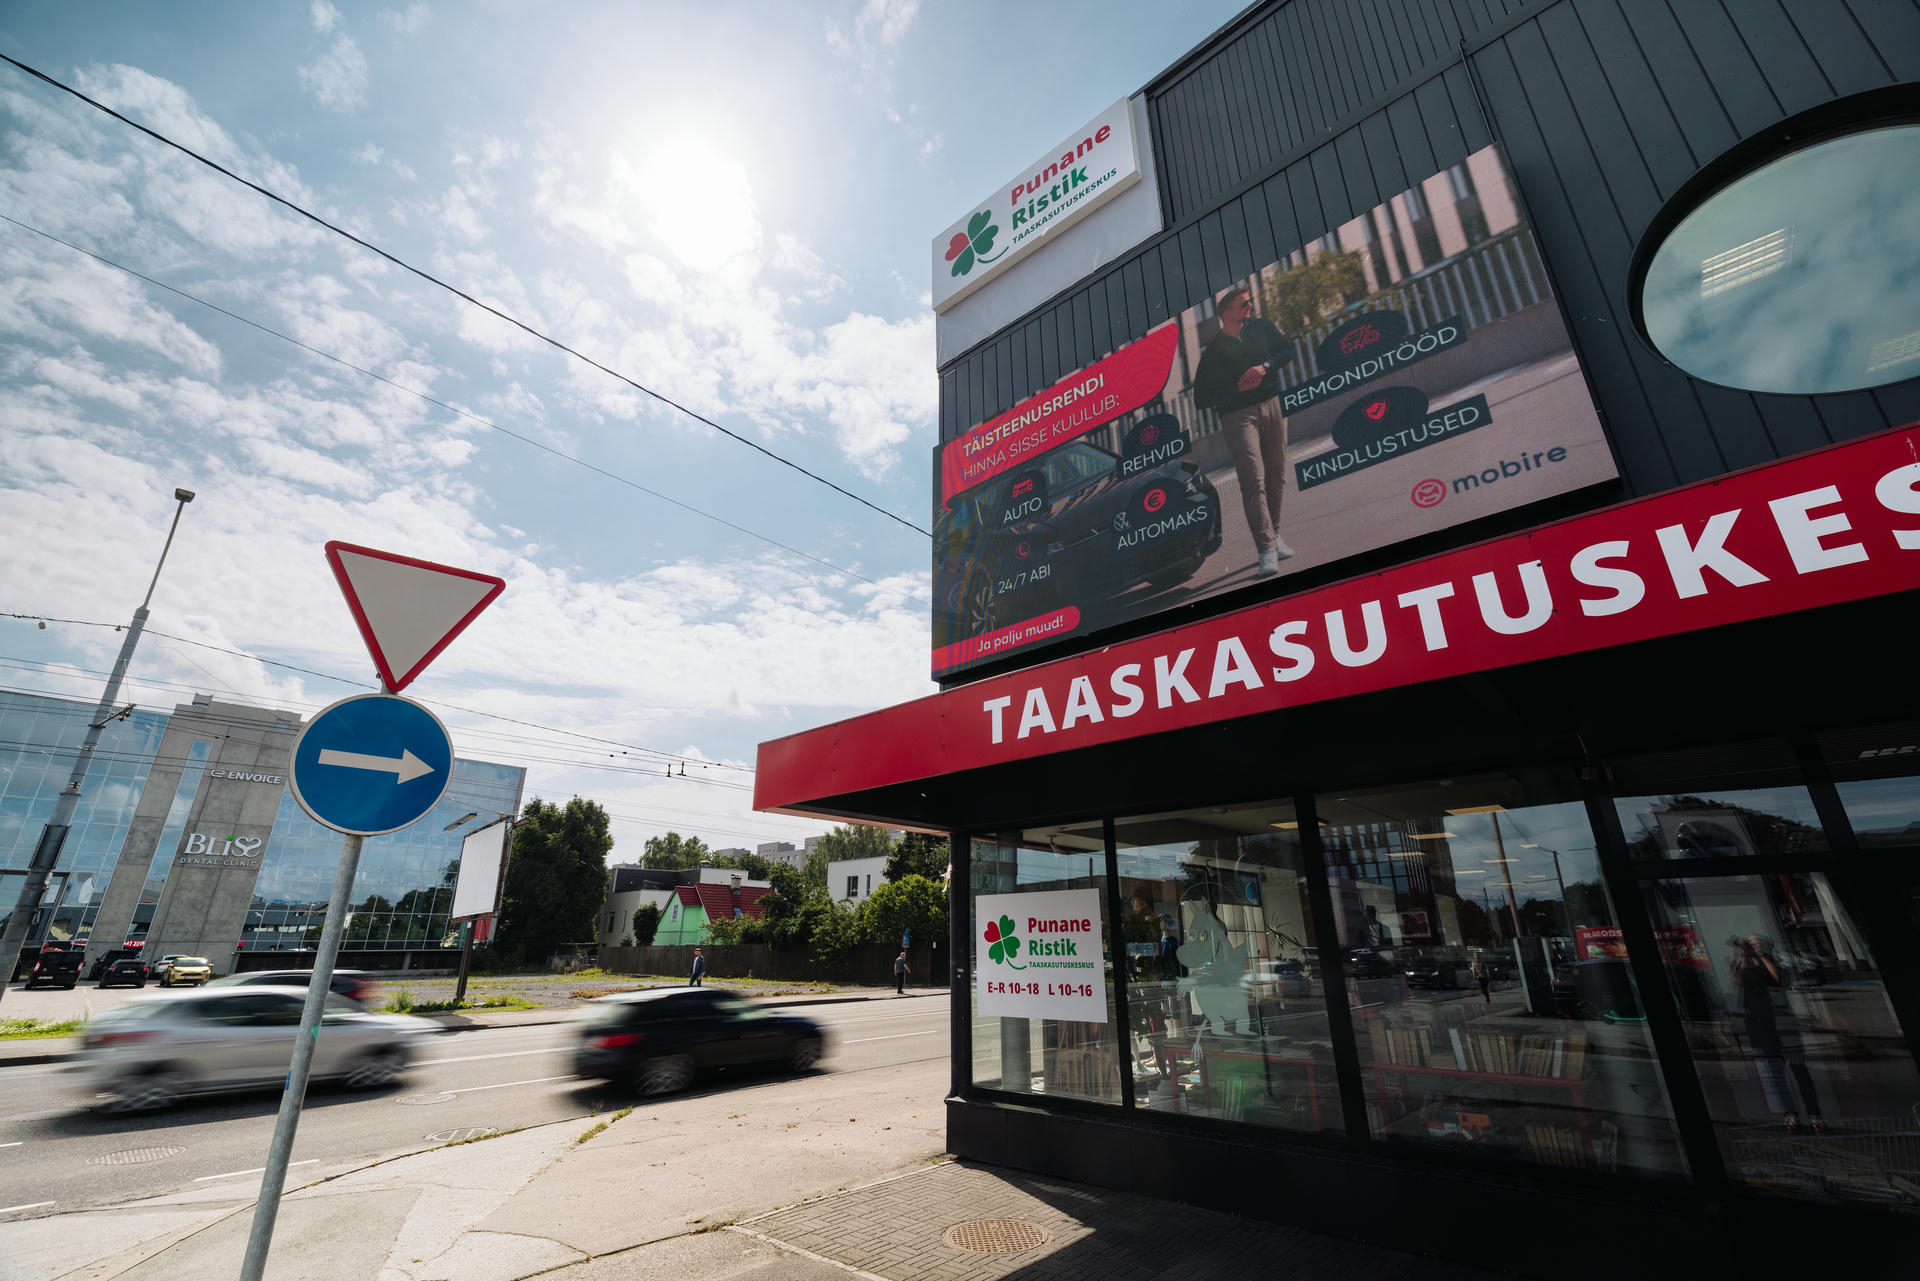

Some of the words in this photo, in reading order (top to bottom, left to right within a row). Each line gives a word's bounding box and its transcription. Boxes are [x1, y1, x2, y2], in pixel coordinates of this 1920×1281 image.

[1011, 124, 1111, 206] Punane
[1012, 165, 1089, 231] Ristik
[1012, 168, 1117, 244] TAASKASUTUSKESKUS
[1284, 326, 1458, 411] REMONDITÖÖD
[963, 373, 1105, 457] TÄISTEENUSRENDI
[963, 451, 1006, 480] HINNA
[1009, 432, 1048, 459] SISSE
[1052, 395, 1120, 435] KUULUB:
[1302, 406, 1480, 483] KINDLUSTUSED
[1123, 438, 1185, 476] REHVID
[1452, 446, 1567, 494] mobire
[1003, 497, 1042, 524] AUTO
[1117, 506, 1208, 550] AUTOMAKS
[998, 573, 1027, 595] 24/7
[1030, 565, 1051, 583] ABI
[977, 637, 991, 653] Ja
[993, 628, 1023, 650] palju
[1025, 615, 1064, 637] muud!
[228, 771, 282, 784] ENVOICE
[180, 857, 218, 865] DENTAL
[223, 859, 257, 867] CLINIC
[1028, 917, 1091, 933] Punane
[1028, 938, 1077, 956] Ristik
[1028, 961, 1095, 969] TAASKASUTUSKESKUS
[1048, 983, 1055, 995] L
